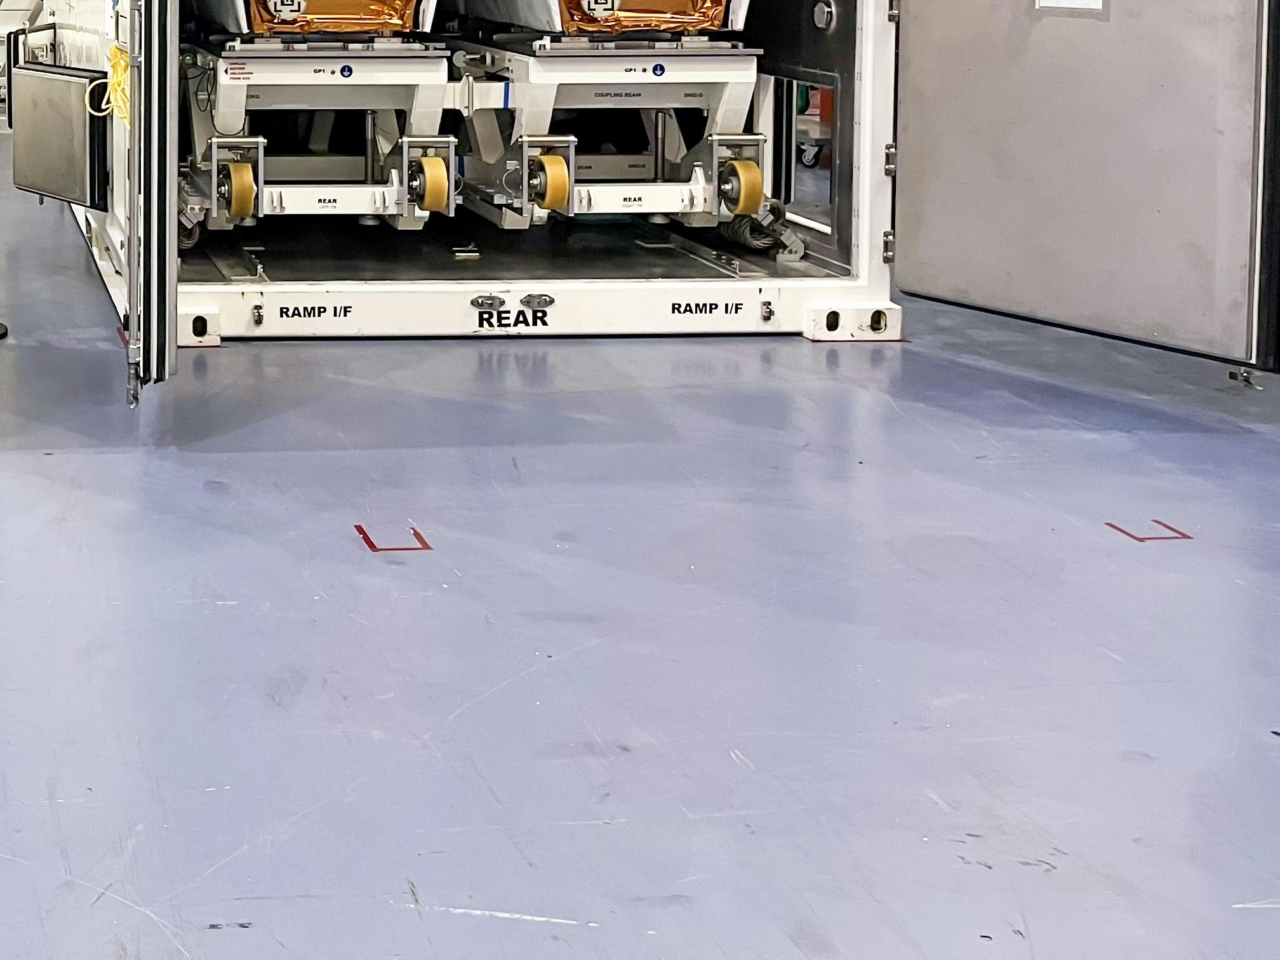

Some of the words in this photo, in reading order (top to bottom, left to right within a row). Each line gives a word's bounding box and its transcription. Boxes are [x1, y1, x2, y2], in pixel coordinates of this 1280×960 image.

[280, 307, 326, 318] RAMP
[334, 306, 352, 317] I/F
[672, 303, 718, 314] RAMP
[725, 303, 743, 314] I/F
[477, 309, 548, 328] REAR
